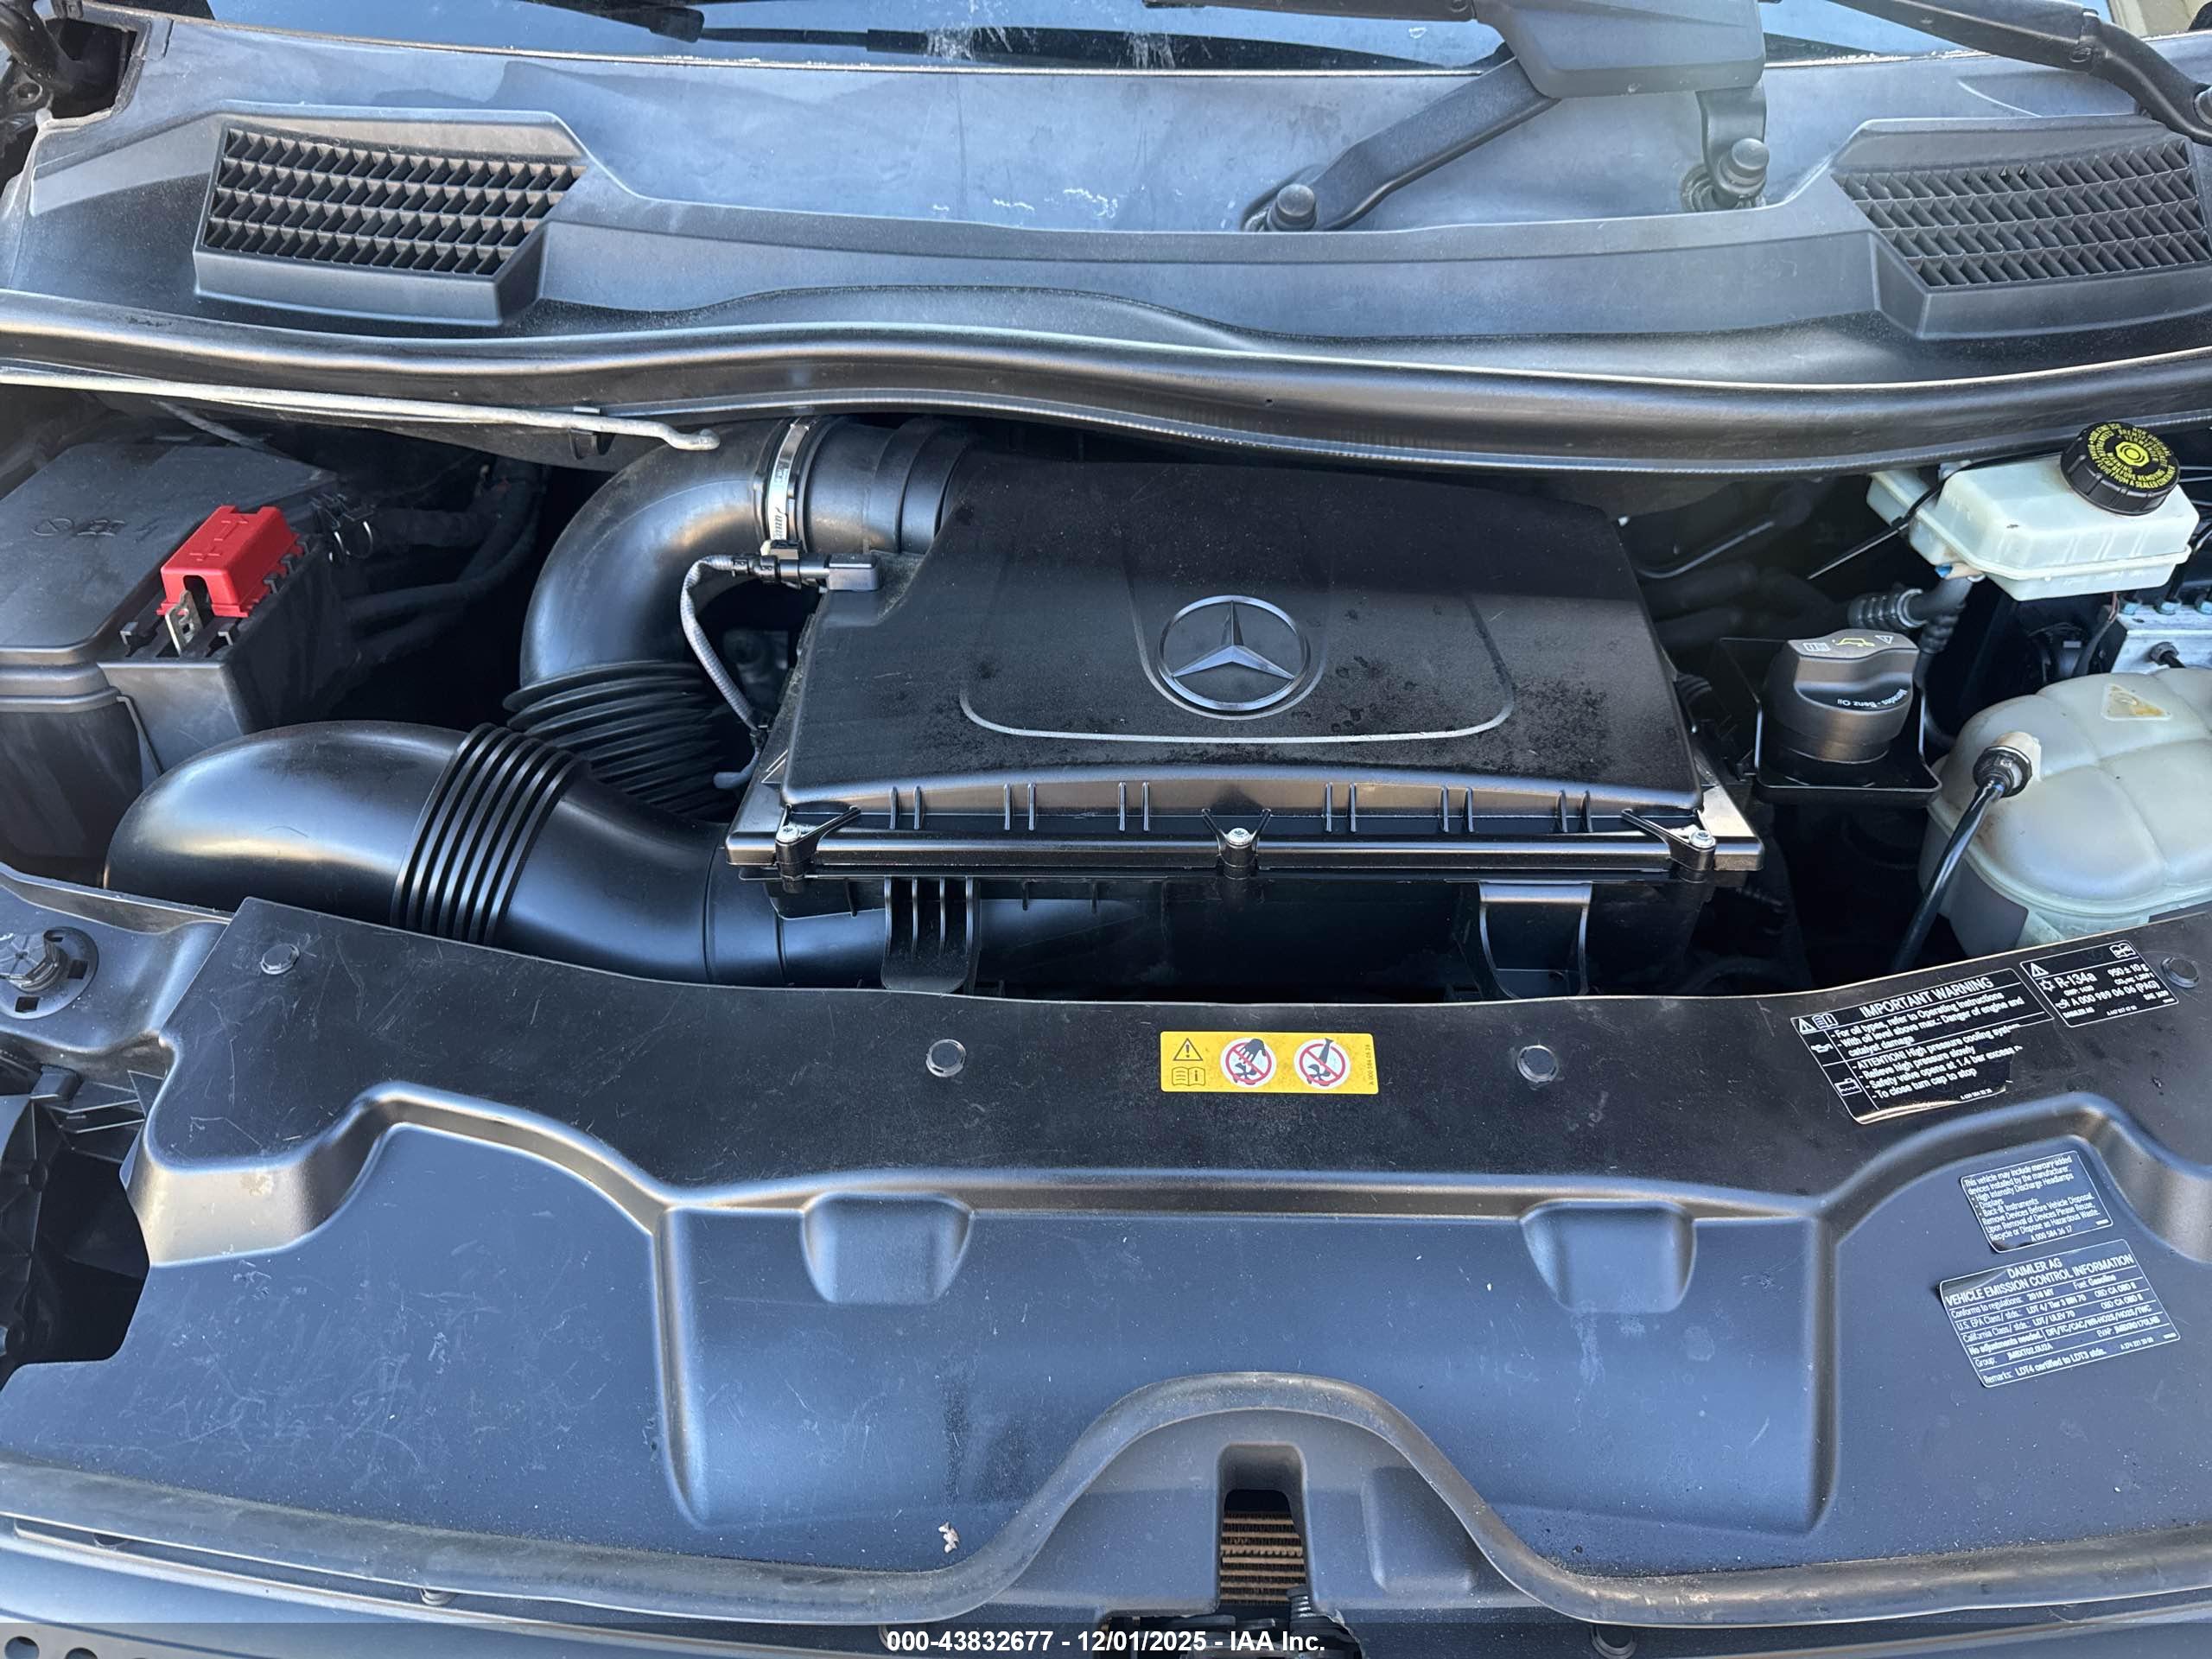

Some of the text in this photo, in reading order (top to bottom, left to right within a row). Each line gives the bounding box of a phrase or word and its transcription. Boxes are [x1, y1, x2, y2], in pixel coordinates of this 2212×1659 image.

[2054, 972, 2097, 988] R-134a
[2078, 995, 2095, 1003] 000
[2094, 991, 2111, 1000] 989
[2112, 988, 2124, 996] 06
[2124, 985, 2136, 994] 06
[2135, 981, 2160, 993] (PAG)
[1859, 977, 1993, 1017] IMPORTANT WARNING
[1840, 1037, 1862, 1046] With
[1862, 1033, 1873, 1042] oil
[1872, 1029, 1893, 1039] level
[1893, 1024, 1918, 1034] above
[1940, 1011, 1970, 1023] Danger
[1980, 1002, 2008, 1013] engine
[2008, 996, 2024, 1007] and
[1851, 1026, 1862, 1034] oil
[1861, 1022, 1888, 1033] types,
[1887, 1016, 1907, 1026] refer
[1917, 1004, 1959, 1018] Operating
[1956, 993, 2004, 1008] Instructions
[1848, 1036, 1914, 1057] catalyst damage
[1858, 1051, 1907, 1069] ATTENTION!
[1905, 1046, 1927, 1057] High
[1926, 1039, 1962, 1053] pressure
[1962, 1031, 1994, 1043] cooling
[1862, 1046, 1975, 1078] Relieve high pressure slowly
[1869, 1077, 1897, 1089] Safety
[1897, 1071, 1920, 1081] valve
[1920, 1065, 1946, 1077] opens
[1956, 1057, 1971, 1066] 1.4
[1969, 1054, 1985, 1063] bar
[1986, 1047, 2014, 1058] excess
[1875, 1090, 1889, 1098] To
[1889, 1085, 1912, 1096] close
[1930, 1076, 1947, 1084] cap
[1957, 1068, 1977, 1077] stop
[1968, 1185, 1990, 1195] devices
[1990, 1178, 2014, 1189] installed
[1975, 1173, 2074, 1201] High Intensity Discharge Headlamps
[1977, 1174, 1997, 1184] vehicle
[2011, 1166, 2031, 1176] include
[1979, 1198, 2004, 1209] Displays
[1982, 1215, 2005, 1225] Remove
[2005, 1210, 2029, 1219] Devices
[2028, 1205, 2048, 1214] Before
[2046, 1199, 2068, 1209] Vehicle
[2005, 1198, 2039, 1211] Instruments
[1986, 1224, 2002, 1233] Upon
[2001, 1217, 2027, 1229] Removal
[2033, 1211, 2056, 1222] Devices
[2056, 1207, 2075, 1216] Please
[1989, 1230, 2012, 1241] Recycle
[2019, 1224, 2043, 1234] Dispose
[2050, 1214, 2081, 1225] Hazardous
[1945, 1254, 2134, 1306] VEHICLE EMISSION CONTROL INFORMATION
[2006, 1258, 2063, 1278] DAIMLER AG
[1951, 1306, 1980, 1319] Conforms
[2027, 1291, 2044, 1300] 2018
[2088, 1274, 2116, 1286] Gasoline
[1963, 1331, 1993, 1342] California
[1992, 1324, 2012, 1335] Class/
[2049, 1313, 2065, 1321] ULEV
[1970, 1319, 1985, 1327] EPA
[1984, 1313, 2004, 1324] Class/
[2026, 1305, 2038, 1313] LDT
[1980, 1338, 2018, 1352] adjustments
[1975, 1357, 1997, 1367] Group:
[2015, 1365, 2034, 1376] LDT4
[2035, 1357, 2063, 1371] certified
[2069, 1351, 2088, 1362] LDT3
